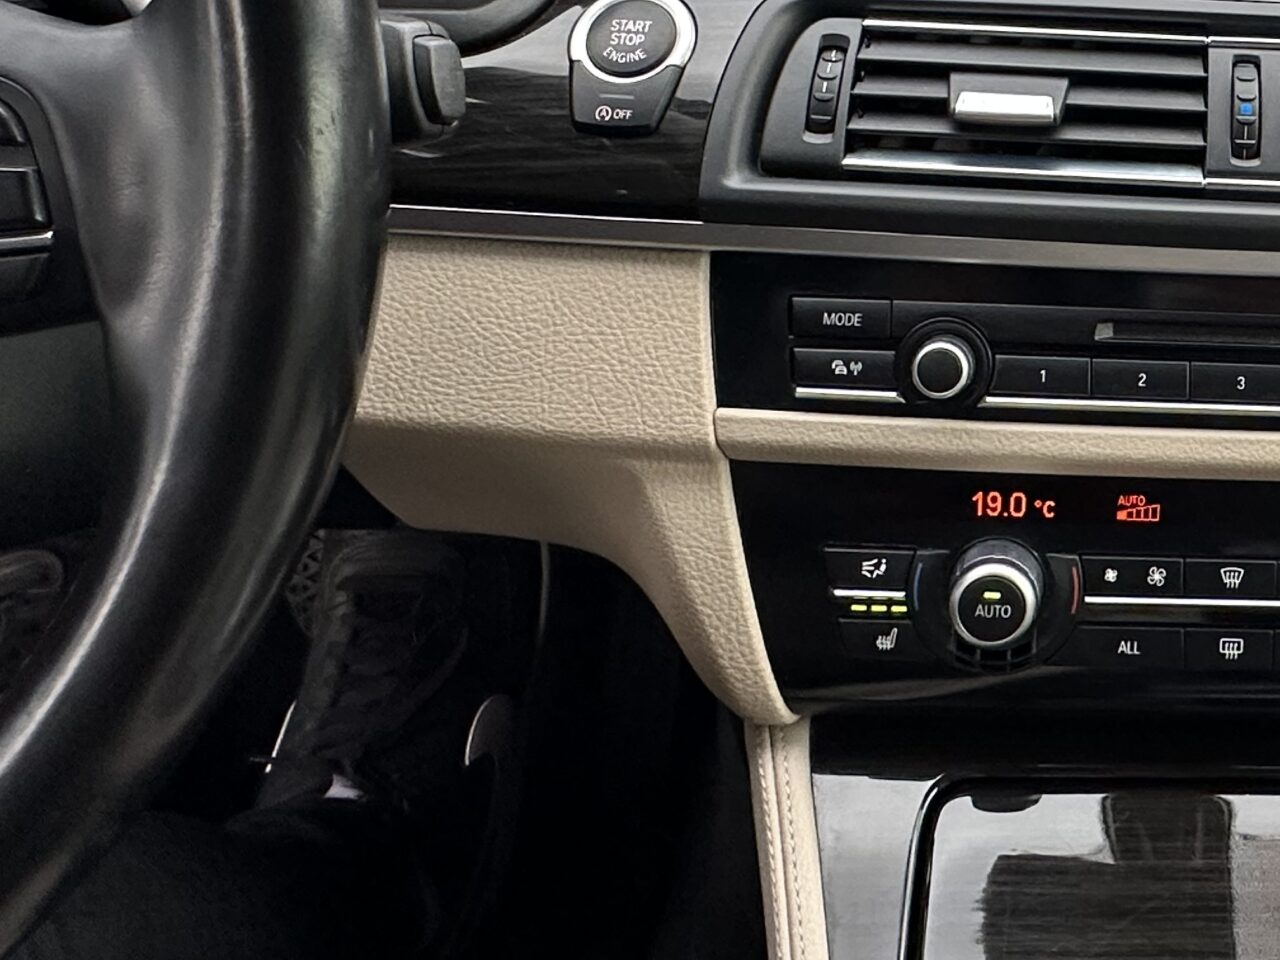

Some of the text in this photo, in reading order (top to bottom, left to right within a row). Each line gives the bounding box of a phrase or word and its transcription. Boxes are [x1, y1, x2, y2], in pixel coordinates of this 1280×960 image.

[610, 19, 653, 33] START
[610, 32, 645, 46] STOP
[603, 46, 647, 63] ENGINE
[613, 108, 633, 120] OFF
[822, 311, 863, 328] MODE
[1040, 369, 1046, 383] 1
[1138, 372, 1147, 387] 2
[1236, 376, 1246, 390] 3
[972, 491, 1027, 518] 19.0
[1117, 495, 1146, 506] AUTO
[974, 603, 1012, 620] AUTO
[1117, 640, 1141, 656] ALL
